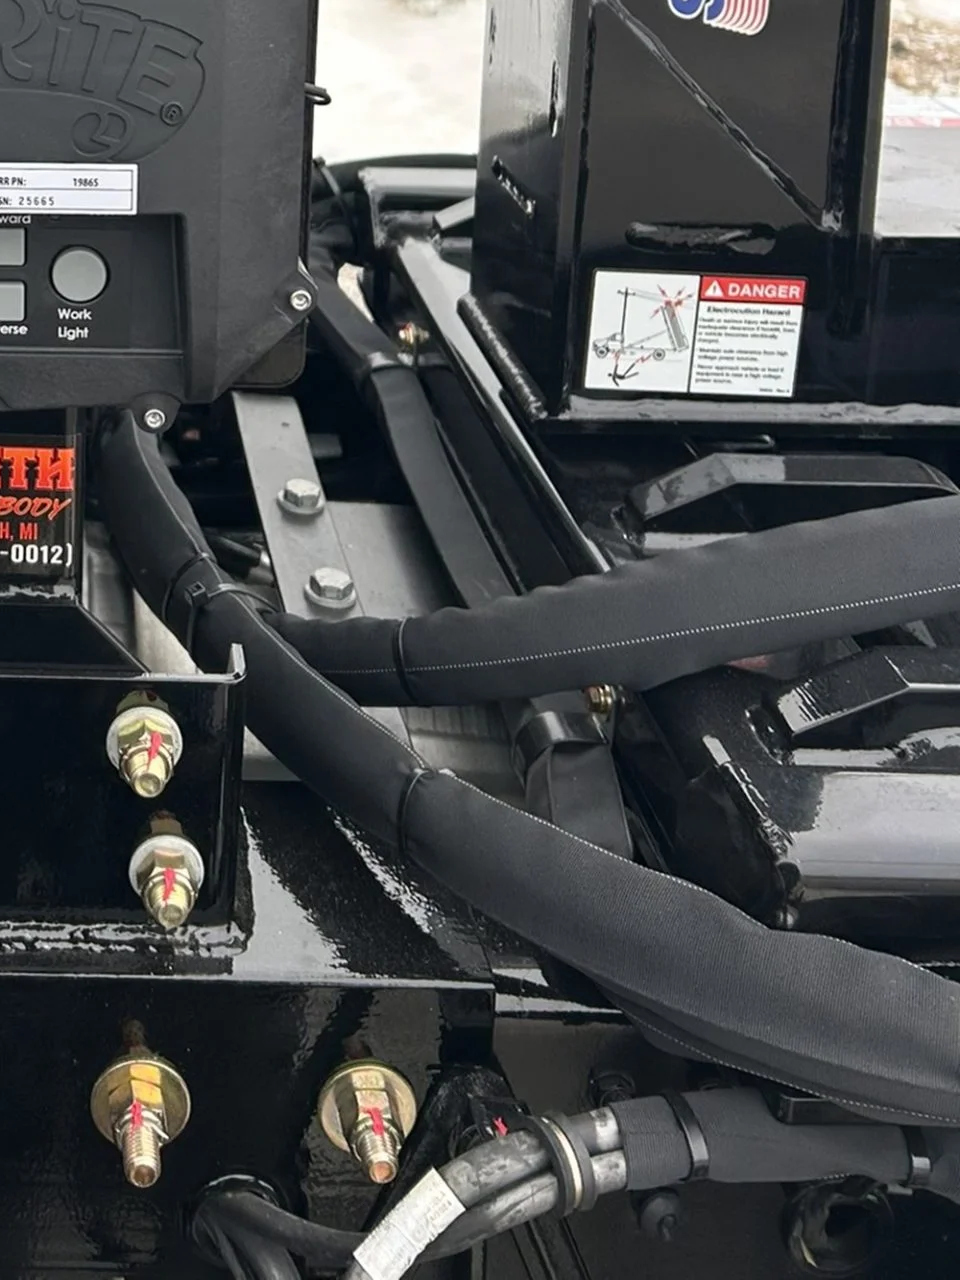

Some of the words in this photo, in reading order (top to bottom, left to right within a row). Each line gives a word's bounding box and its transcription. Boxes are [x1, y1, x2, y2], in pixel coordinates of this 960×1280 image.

[11, 176, 26, 186] PN:
[73, 178, 99, 187] 19865
[727, 282, 800, 299] DANGER
[58, 308, 92, 320] Work
[762, 308, 791, 316] Hazard
[58, 326, 89, 340] Light
[20, 522, 38, 540] MI
